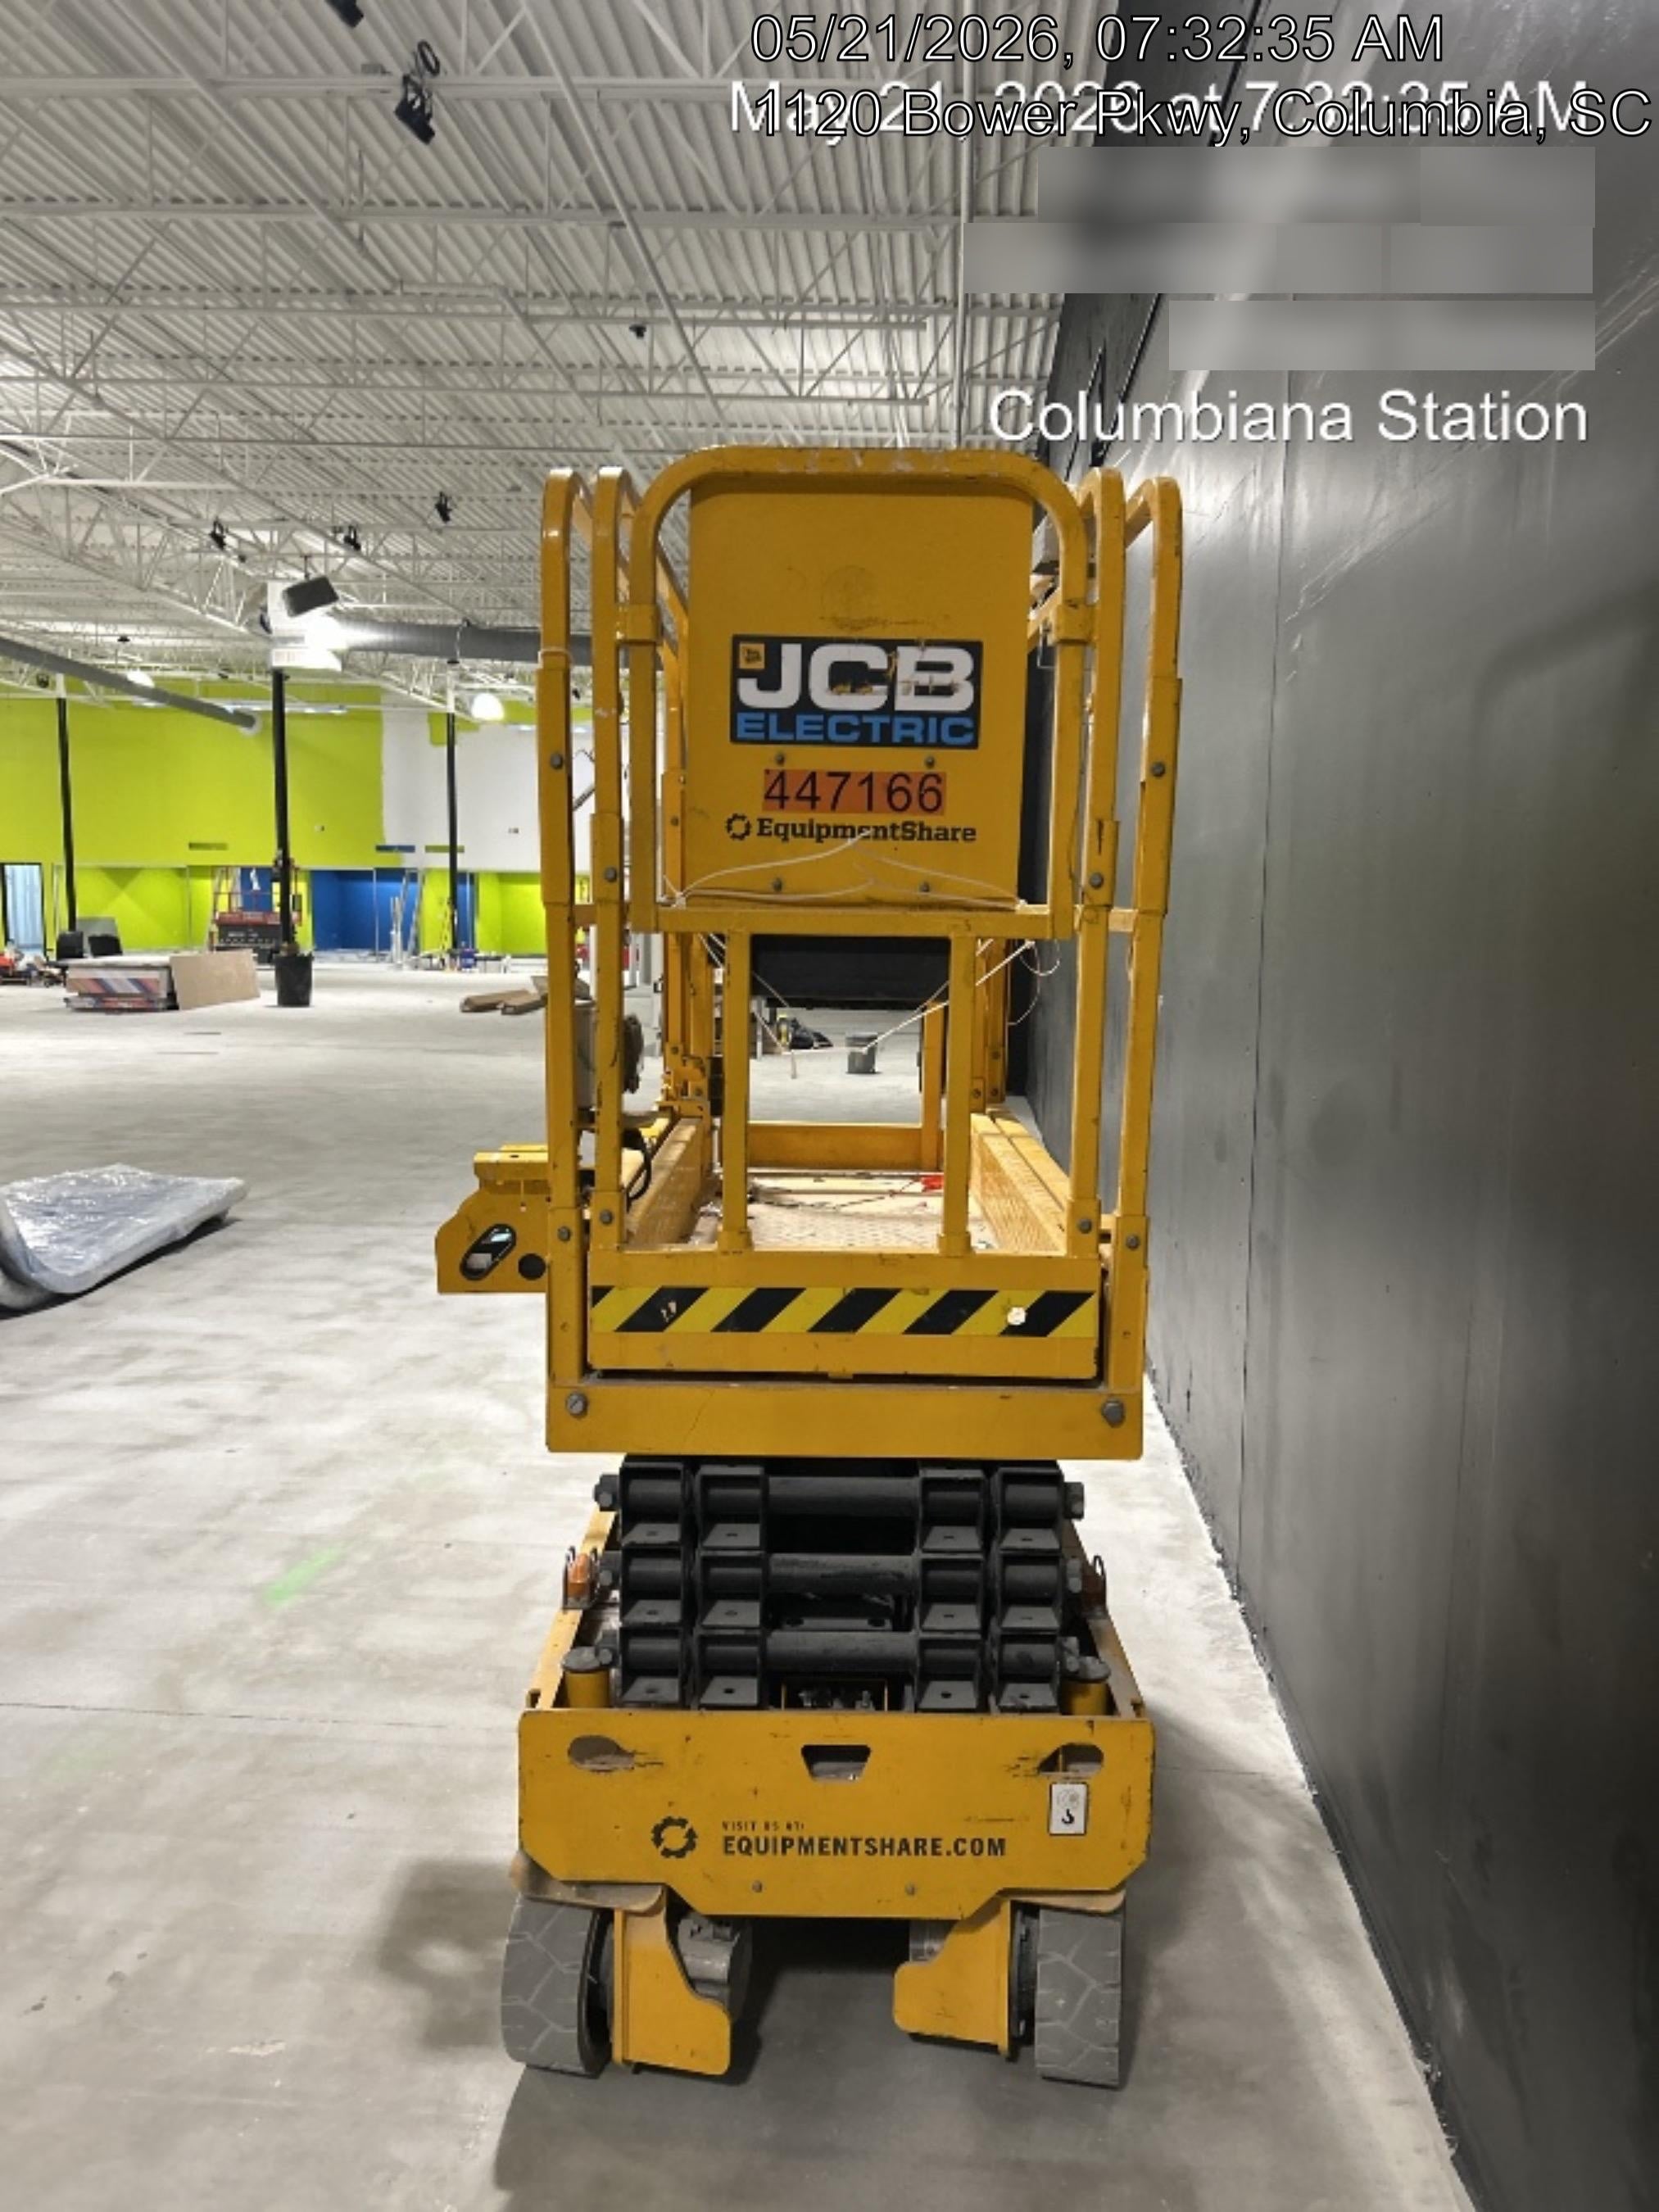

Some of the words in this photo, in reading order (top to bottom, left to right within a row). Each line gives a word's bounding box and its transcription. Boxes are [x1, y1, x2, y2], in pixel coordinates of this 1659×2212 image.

[737, 642, 975, 712] JCB
[737, 712, 975, 744] ELECTRIC
[764, 769, 943, 814] 447166
[757, 818, 977, 844] EquipmentShare
[723, 1835, 1007, 1857] EQUIPMENTSHARE.COM
